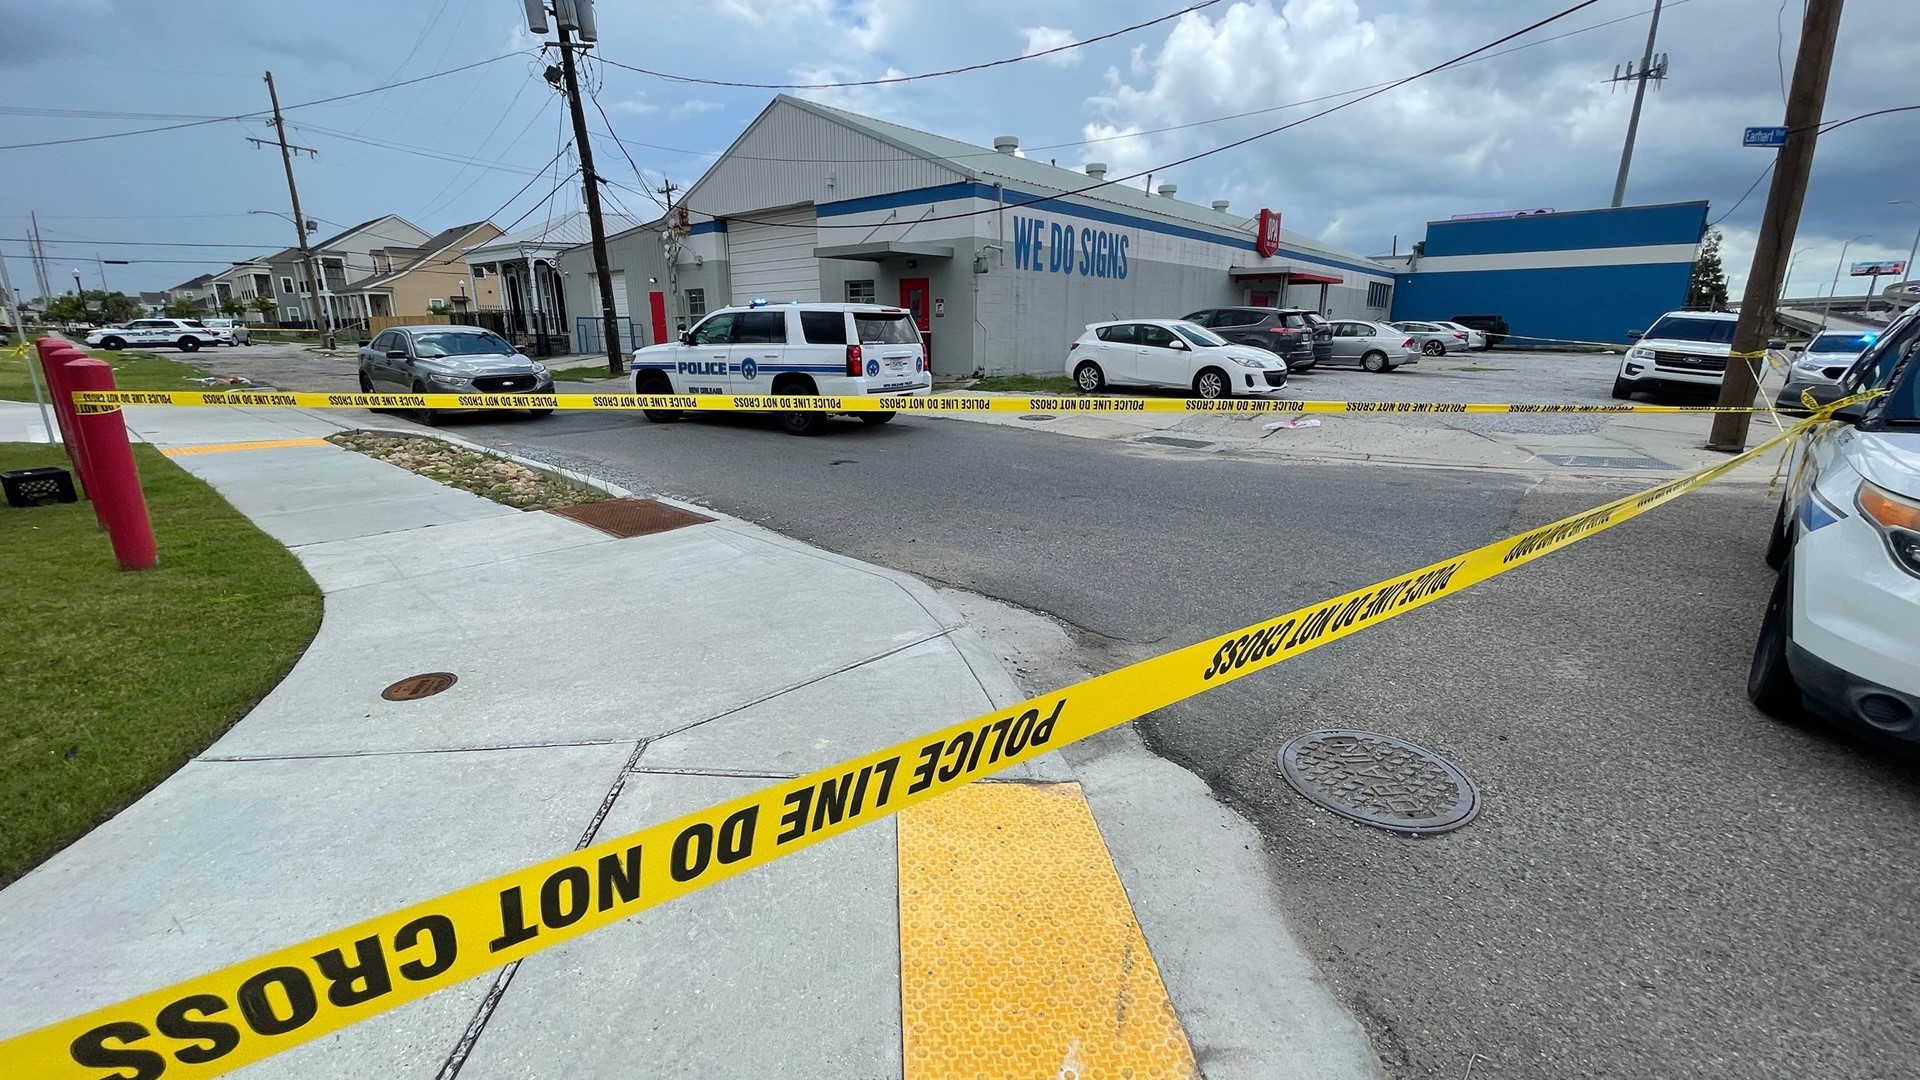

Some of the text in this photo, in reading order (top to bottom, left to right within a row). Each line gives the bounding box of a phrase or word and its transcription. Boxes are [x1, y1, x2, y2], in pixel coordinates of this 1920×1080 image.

[1745, 130, 1774, 142] Earhart
[1013, 215, 1129, 280] WE DO SIGNS
[678, 362, 727, 375] POLICE
[106, 394, 120, 403] NOT
[121, 394, 131, 403] DO
[131, 394, 147, 404] LINE
[149, 394, 172, 404] POLICE
[203, 394, 297, 405] POLICE LINE DO NOT CROSS
[329, 396, 425, 406] POLICE LINE DO NOT CROSS
[459, 396, 558, 406] POLICE LINE DO NOT CROSS
[593, 397, 696, 407] POLICE LINE DO NOT CROSS
[734, 398, 841, 408] POLICE LINE DO NOT CROSS
[81, 404, 98, 414] NOT
[880, 399, 989, 409] POLICE LINE DO NOT CROSS
[1031, 399, 1144, 410] POLICE LINE DO NOT CROSS
[1186, 400, 1304, 411] POLICE LINE DO NOT CROSS
[1346, 402, 1466, 412] POLICE LINE DO NOT CROSS
[1203, 560, 1466, 681] POLICE LINE DO NOT CROSS
[1331, 743, 1428, 813] DRAIN
[70, 699, 1067, 1080] POLICE LINE DO NOT CROSS
